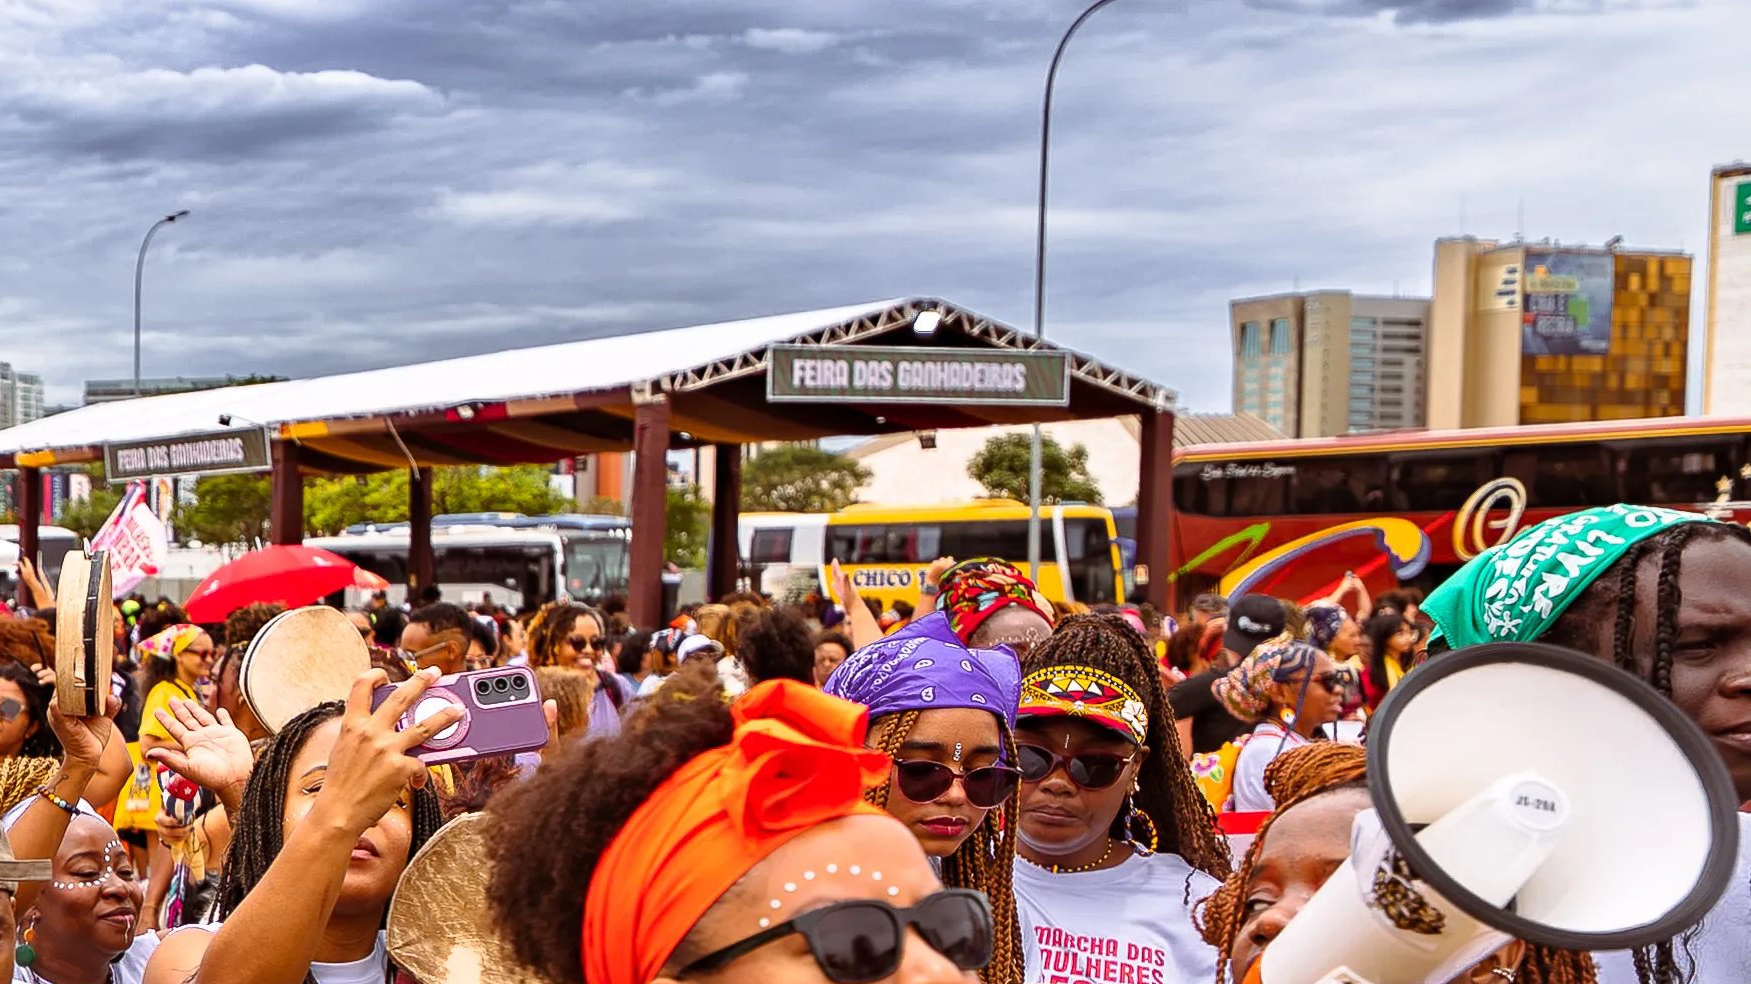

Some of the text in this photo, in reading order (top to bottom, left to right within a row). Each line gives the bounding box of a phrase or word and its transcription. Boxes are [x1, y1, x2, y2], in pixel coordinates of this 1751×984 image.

[791, 357, 1028, 392] FEIRA DAS GANHADEIRAS
[852, 569, 911, 587] CHICO
[1034, 925, 1166, 967] MARCHA DAS
